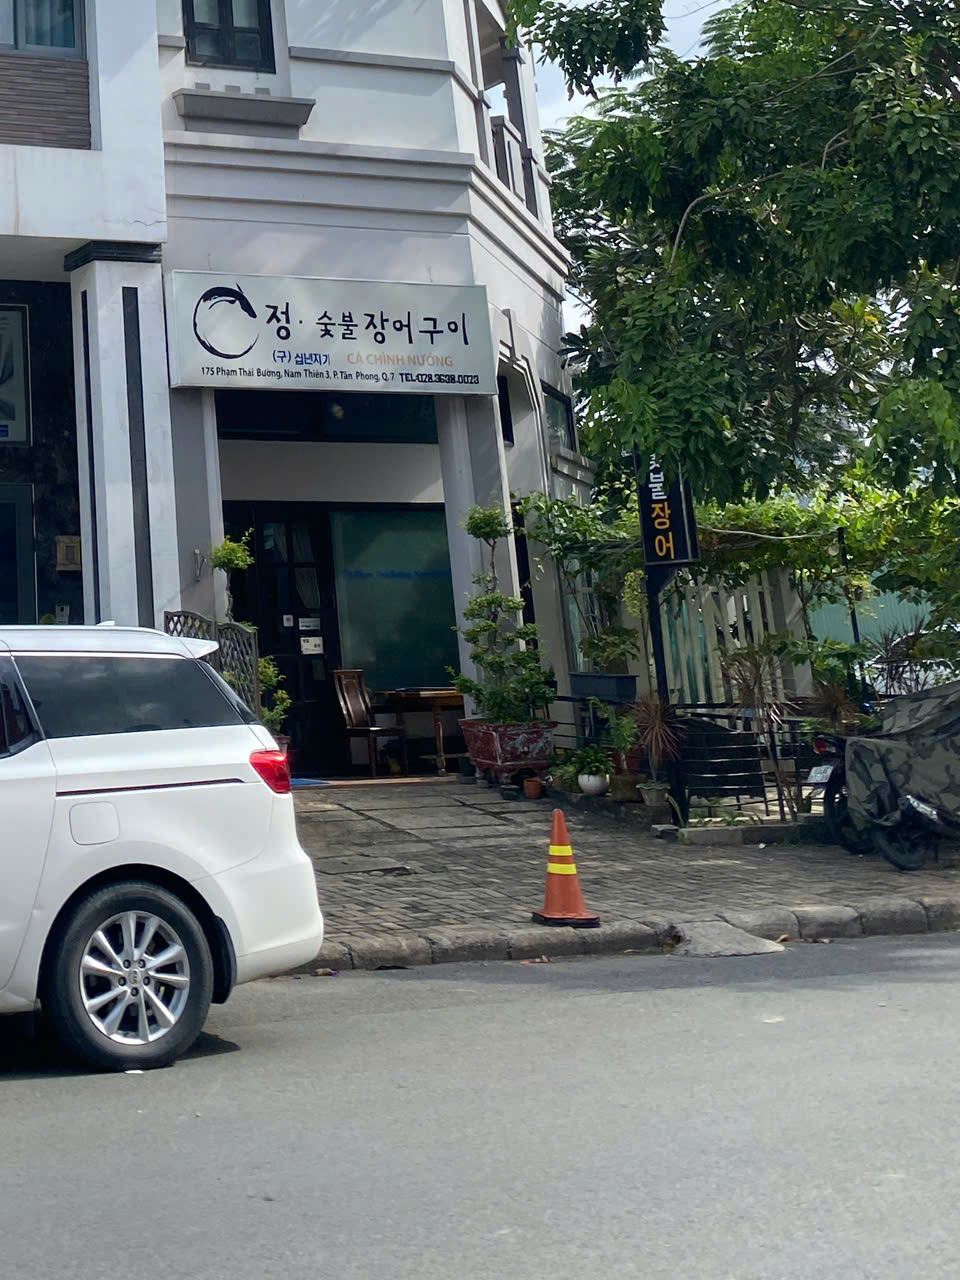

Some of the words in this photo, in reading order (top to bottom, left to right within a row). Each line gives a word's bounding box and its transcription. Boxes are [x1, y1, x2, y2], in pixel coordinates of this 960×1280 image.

[272, 349, 292, 363] (구)
[294, 352, 331, 366] 십년지기
[201, 366, 215, 376] 175
[216, 366, 237, 378] Phạm
[239, 367, 254, 377] Thái
[284, 369, 302, 378] Nam
